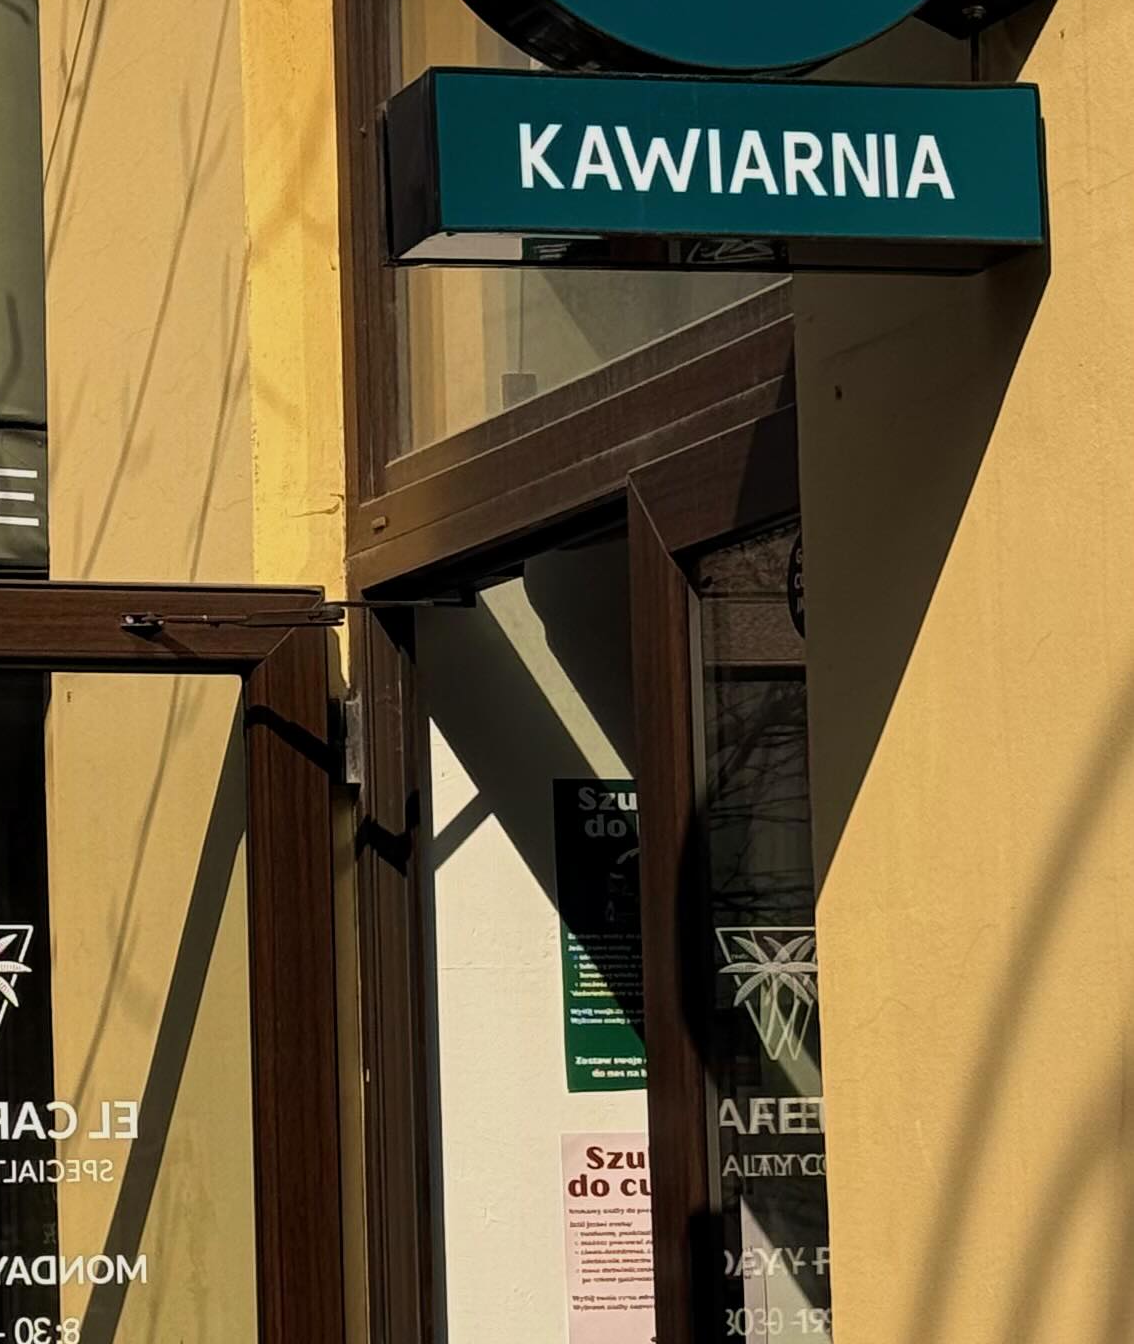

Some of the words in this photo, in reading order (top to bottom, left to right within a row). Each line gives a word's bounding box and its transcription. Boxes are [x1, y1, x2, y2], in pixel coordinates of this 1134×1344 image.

[518, 122, 956, 201] KAWIARNIA
[577, 786, 638, 811] Szu
[584, 813, 628, 838] do
[585, 1146, 646, 1171] Szu
[568, 1173, 610, 1198] do
